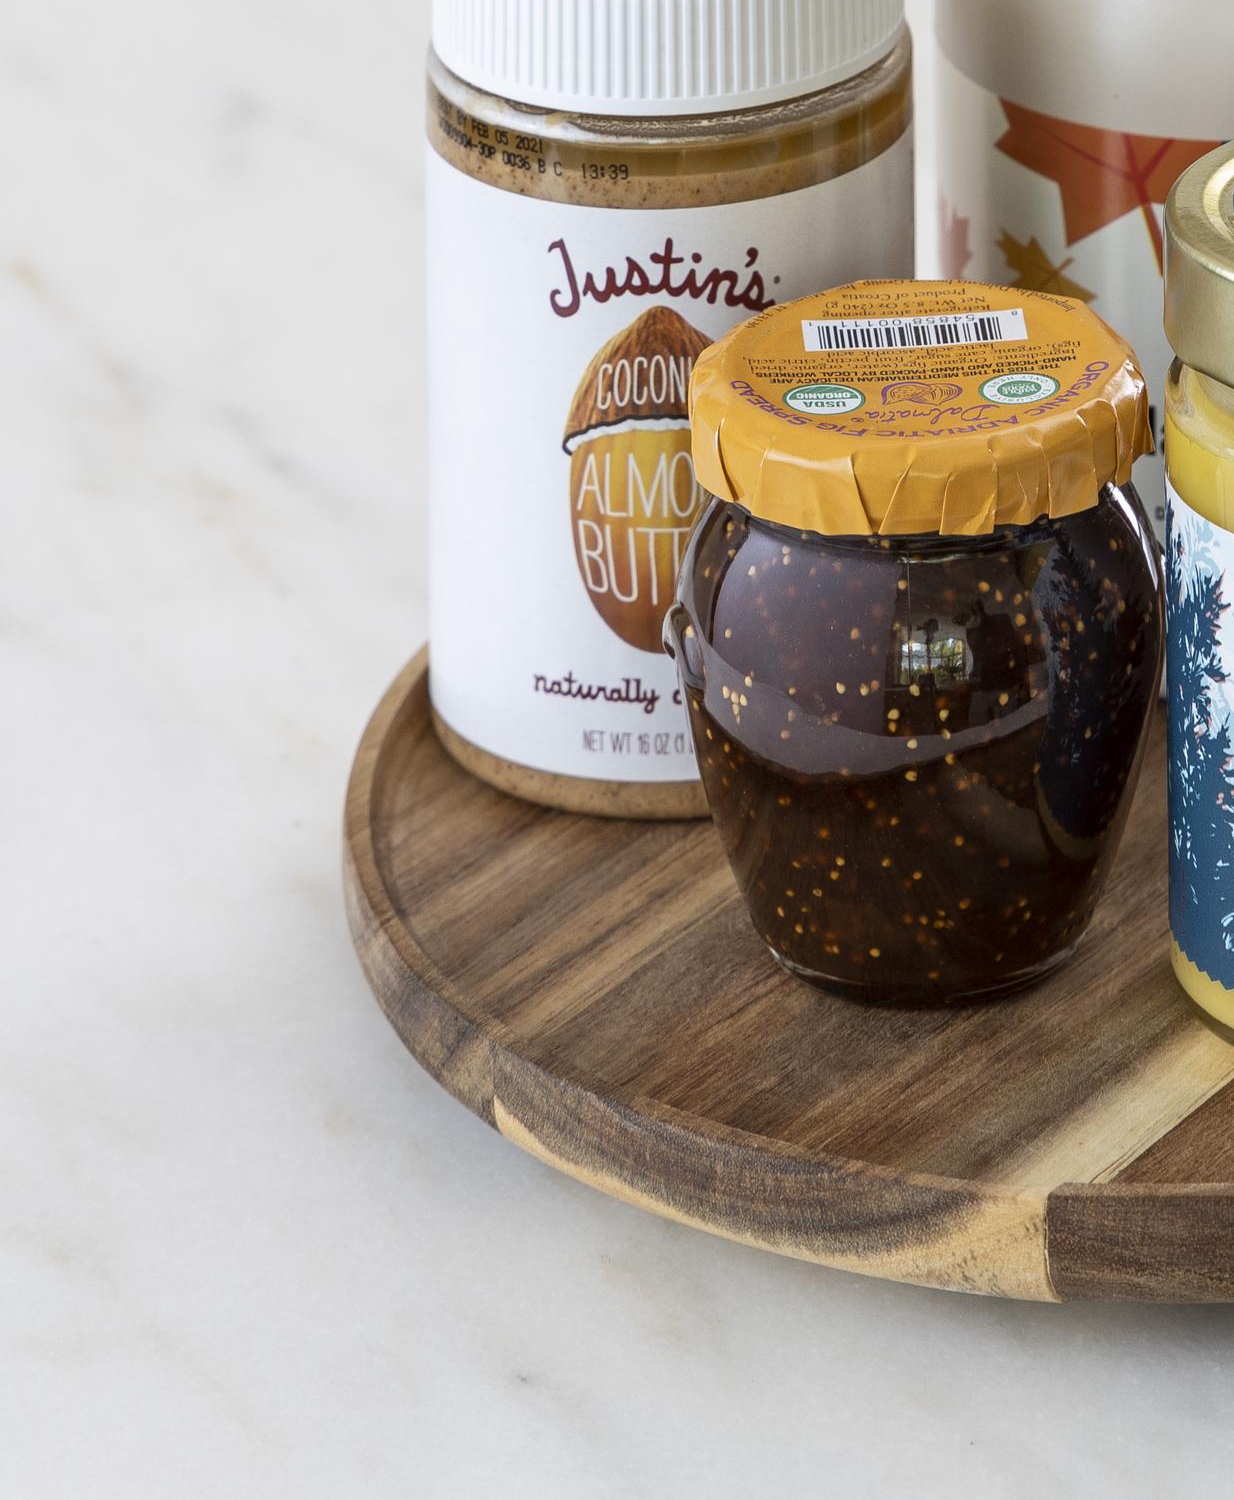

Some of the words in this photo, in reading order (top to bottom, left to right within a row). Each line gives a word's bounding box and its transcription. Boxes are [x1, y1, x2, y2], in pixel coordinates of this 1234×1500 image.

[516, 135, 543, 154] 2021
[538, 158, 546, 174] B
[554, 161, 563, 177] C
[581, 163, 629, 180] 13:39
[547, 237, 777, 319] Justin's
[842, 292, 887, 301] Croatia
[913, 287, 966, 297] Product
[896, 293, 908, 301] of
[961, 296, 986, 304] Net
[825, 300, 839, 310] g)
[843, 301, 874, 309] (240
[878, 301, 898, 309] Oz
[915, 304, 992, 315] Refrigerate
[821, 309, 877, 318] opening
[882, 308, 912, 316] after
[954, 349, 985, 357] cane
[987, 345, 1041, 355] organic
[992, 348, 1075, 361] Ingredients:
[827, 351, 854, 359] acid
[874, 355, 904, 363] fruit
[779, 357, 816, 365] citric
[930, 356, 987, 367] Organic
[995, 355, 1076, 369] HAND-PICKED
[749, 363, 787, 372] dried
[791, 362, 842, 371] organic
[967, 363, 994, 371] AND
[992, 366, 1006, 374] IN
[1006, 365, 1036, 373] FIGS
[1039, 362, 1061, 371] THE
[879, 366, 965, 377] HAND-PACKED
[963, 368, 991, 377] THIS
[769, 377, 795, 385] ARE
[796, 376, 855, 384] DELICACY
[857, 371, 960, 383] MEDITERRANEAN
[1023, 361, 1109, 417] ORGANIC
[796, 391, 851, 400] ORGANIC
[731, 380, 813, 426] SPREAD
[803, 400, 847, 408] USDA
[816, 422, 869, 436] FIG
[875, 415, 1018, 437] ADRIATIC
[577, 451, 703, 518] ALMO
[534, 670, 660, 714] naturally
[583, 730, 605, 753] NET
[610, 731, 633, 754] WT
[654, 732, 671, 755] OZ
